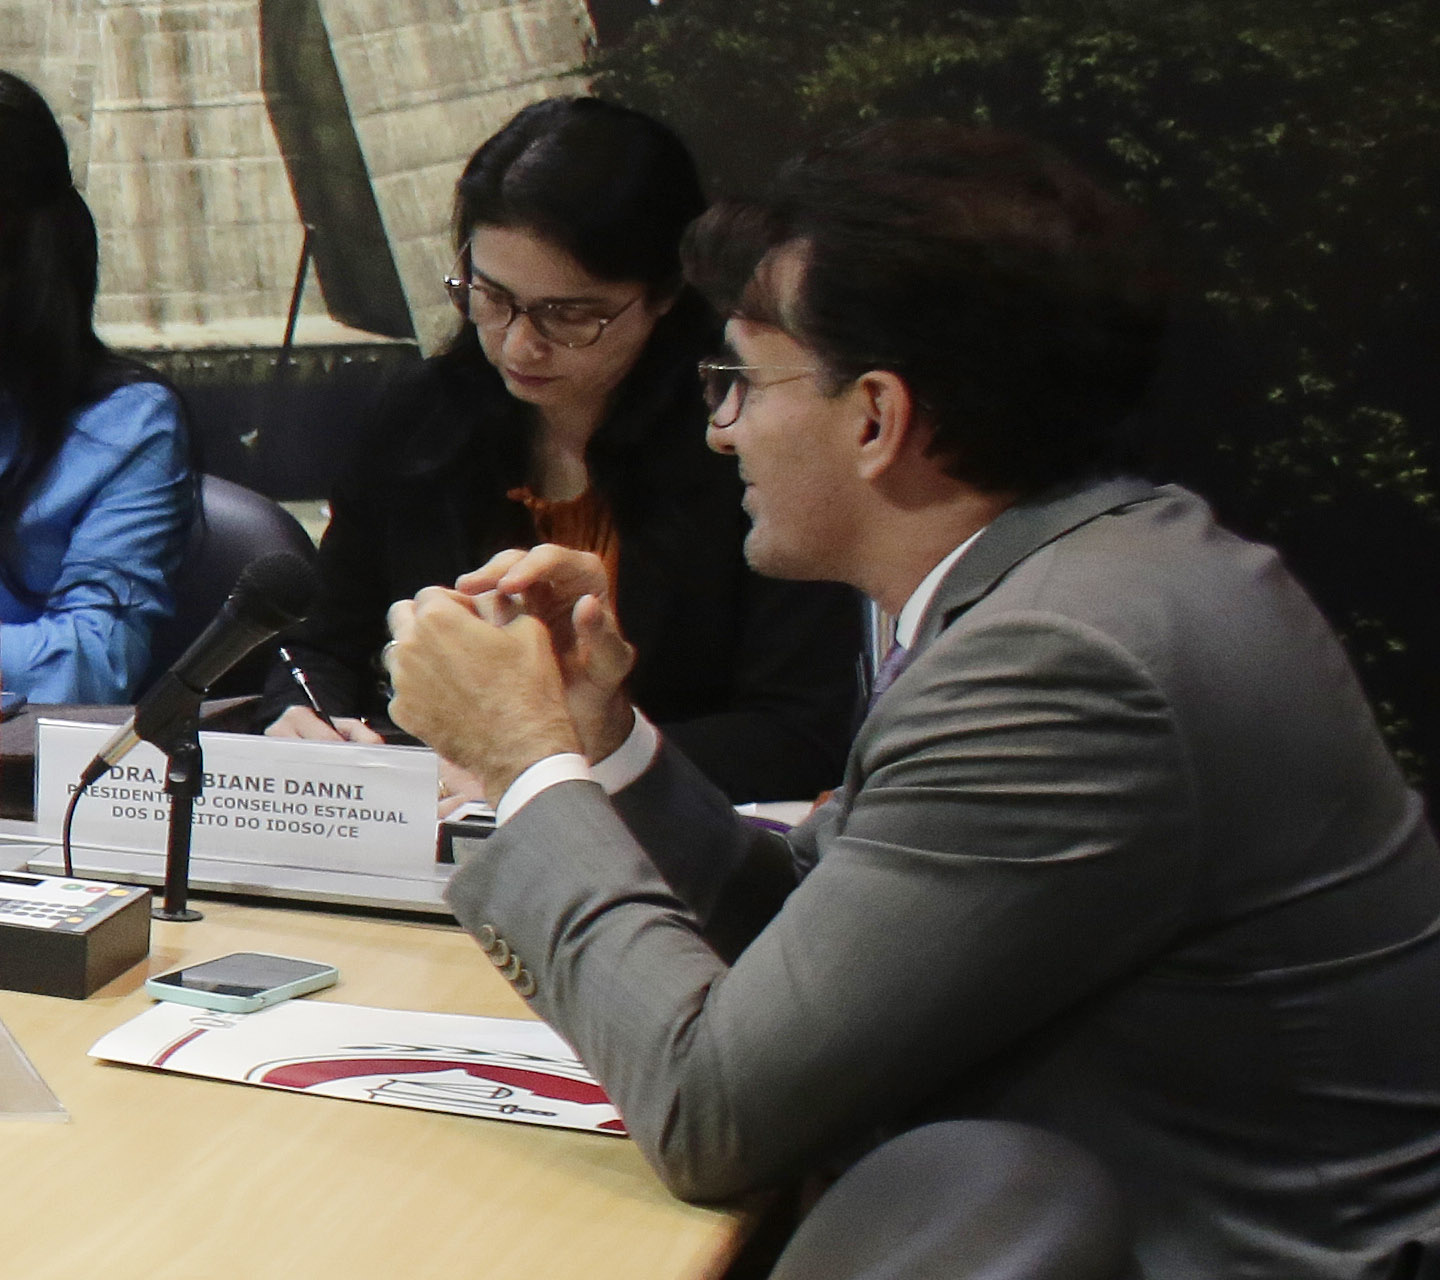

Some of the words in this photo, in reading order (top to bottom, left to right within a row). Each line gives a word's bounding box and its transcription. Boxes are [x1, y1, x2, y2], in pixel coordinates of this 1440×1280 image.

[110, 765, 163, 784] DRA.
[203, 772, 275, 794] BIANE
[285, 779, 364, 800] DANNI
[112, 806, 147, 820] DOS
[235, 818, 259, 830] DO
[266, 819, 359, 838] IDOSO/CE
[213, 797, 307, 816] CONSELHO
[314, 806, 408, 824] ESTADUAL
